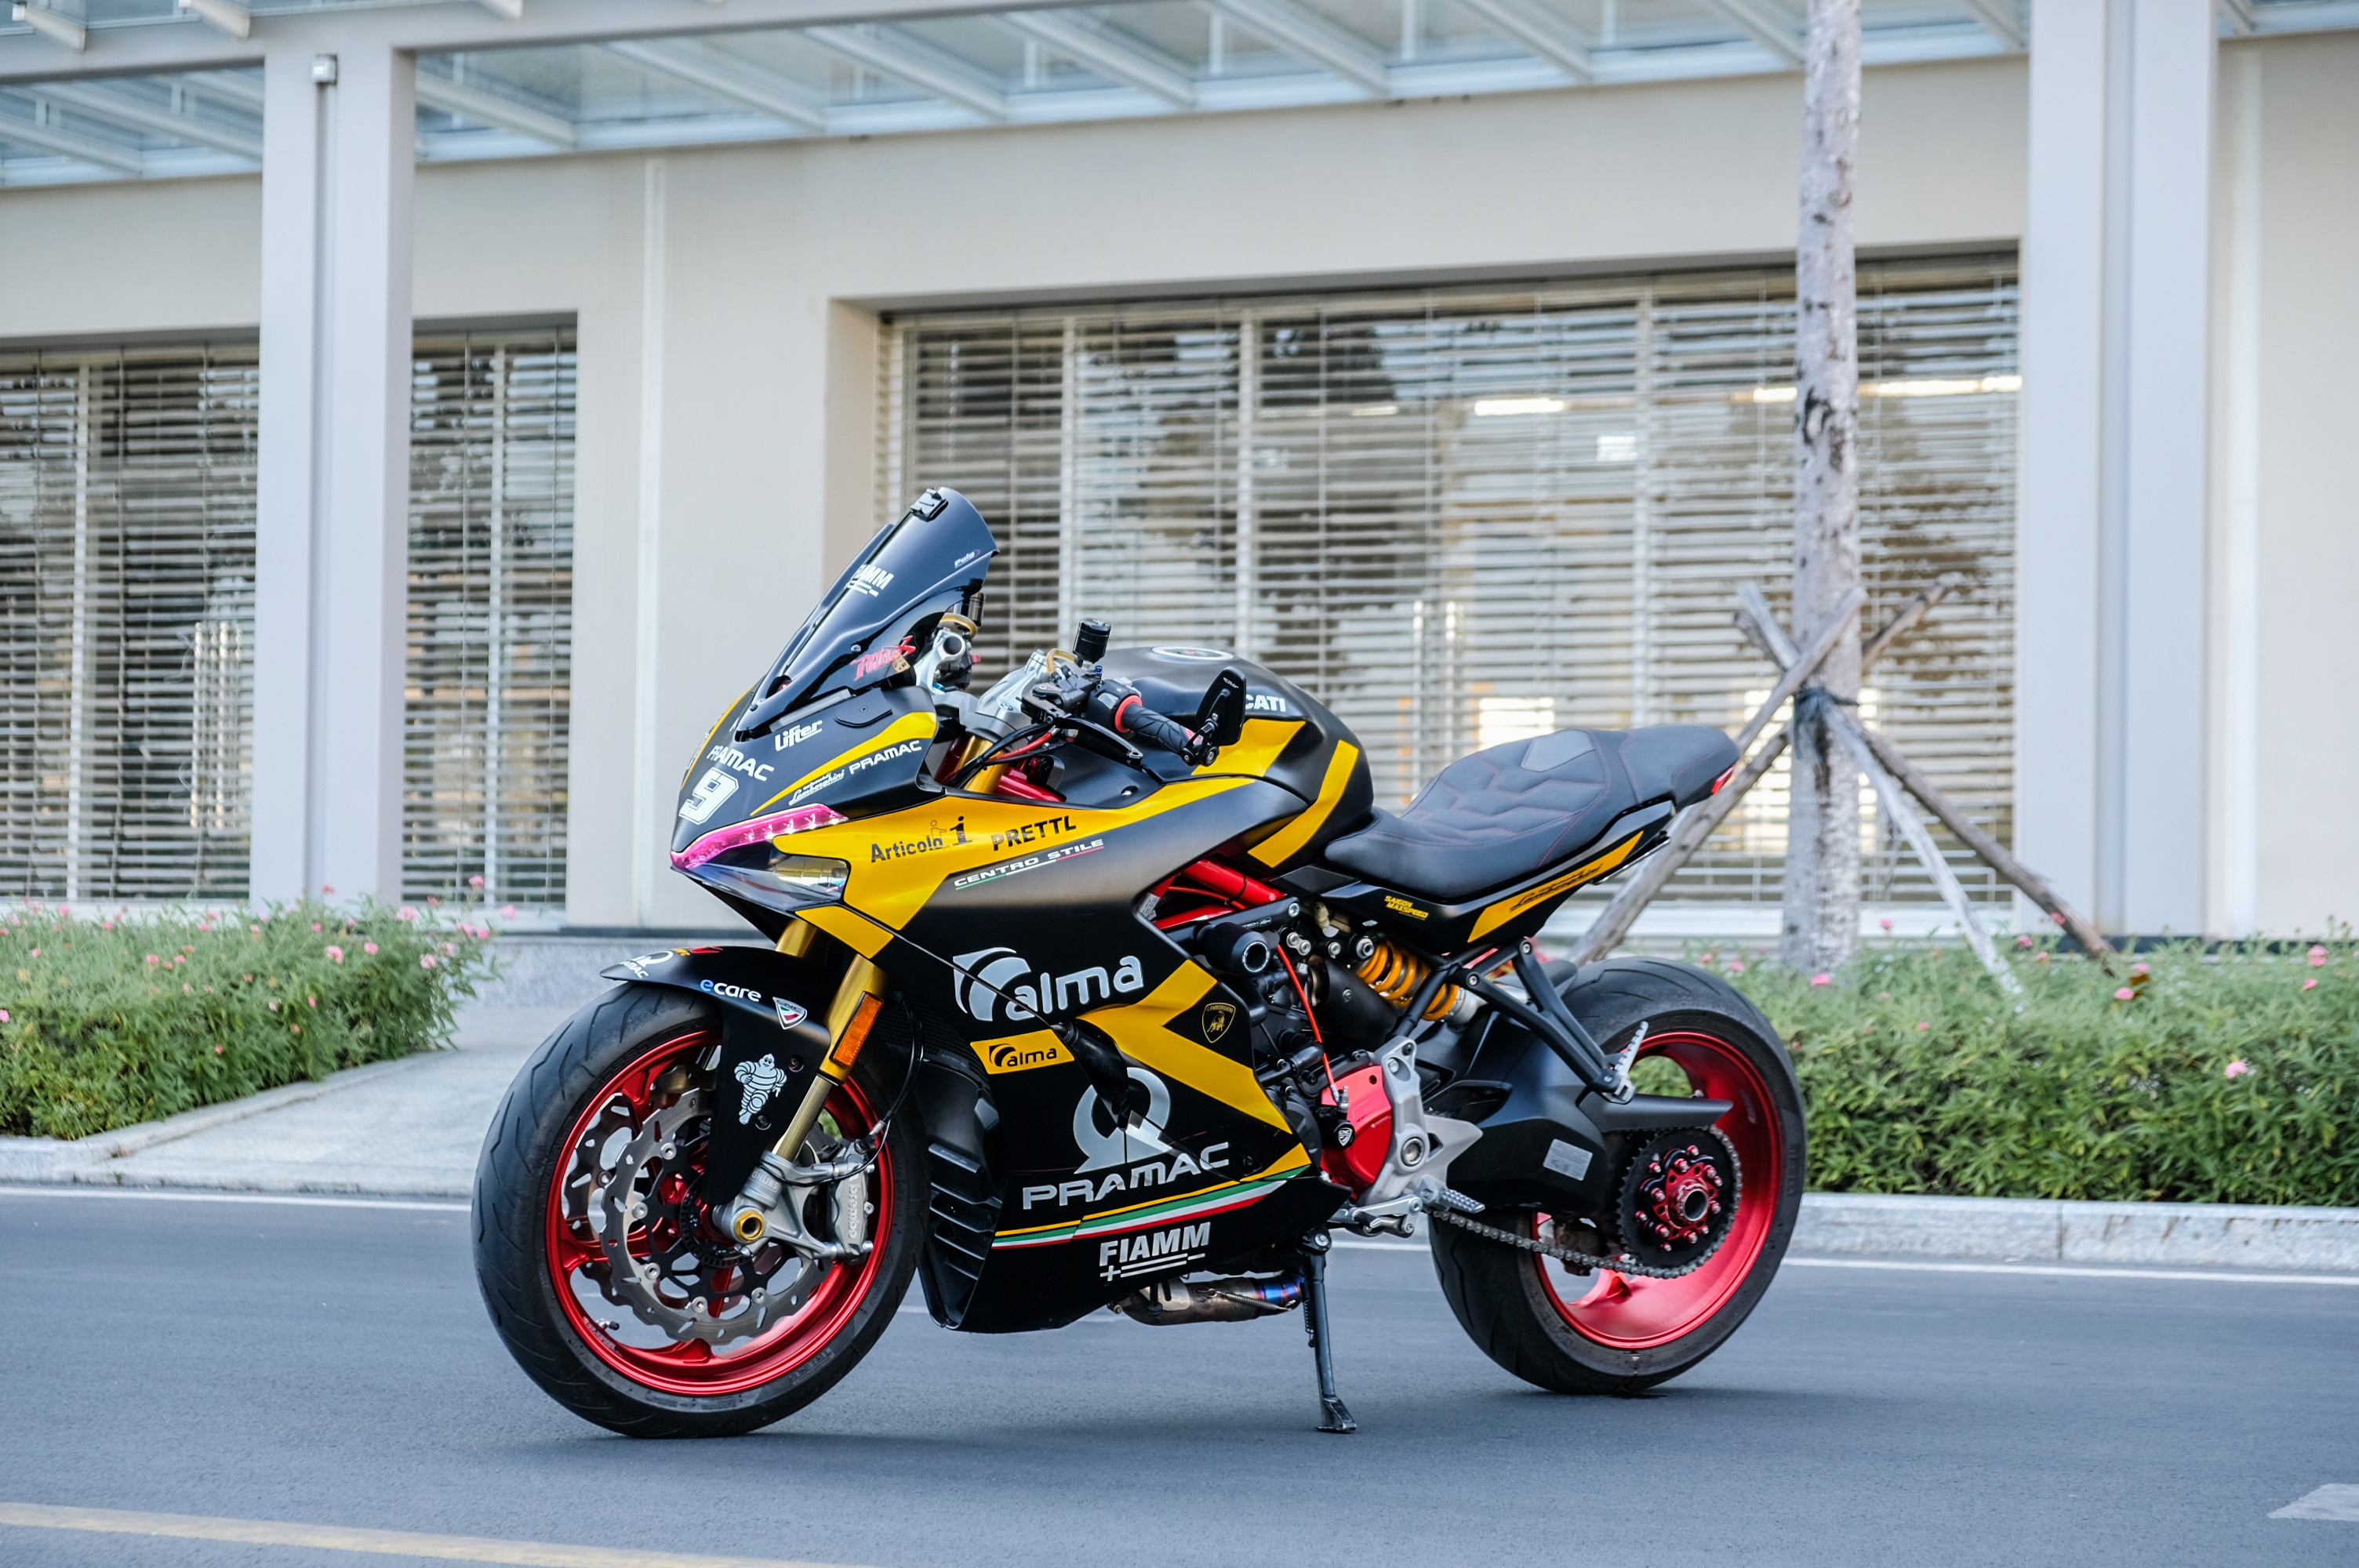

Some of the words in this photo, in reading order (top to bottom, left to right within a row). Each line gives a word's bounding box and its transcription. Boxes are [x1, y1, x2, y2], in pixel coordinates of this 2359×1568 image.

[775, 720, 823, 751] Lifter
[849, 740, 921, 775] PRAMAC
[678, 767, 740, 825] 9
[871, 835, 943, 862] Articolo
[991, 815, 1076, 851] PRETTL
[954, 857, 1039, 887] CENTRO
[1047, 838, 1104, 860] STILE
[700, 979, 761, 1002] ecare
[1023, 1142, 1230, 1210] PRAMAC
[849, 1183, 860, 1239] brembo
[1100, 1221, 1211, 1266] FIAMM
